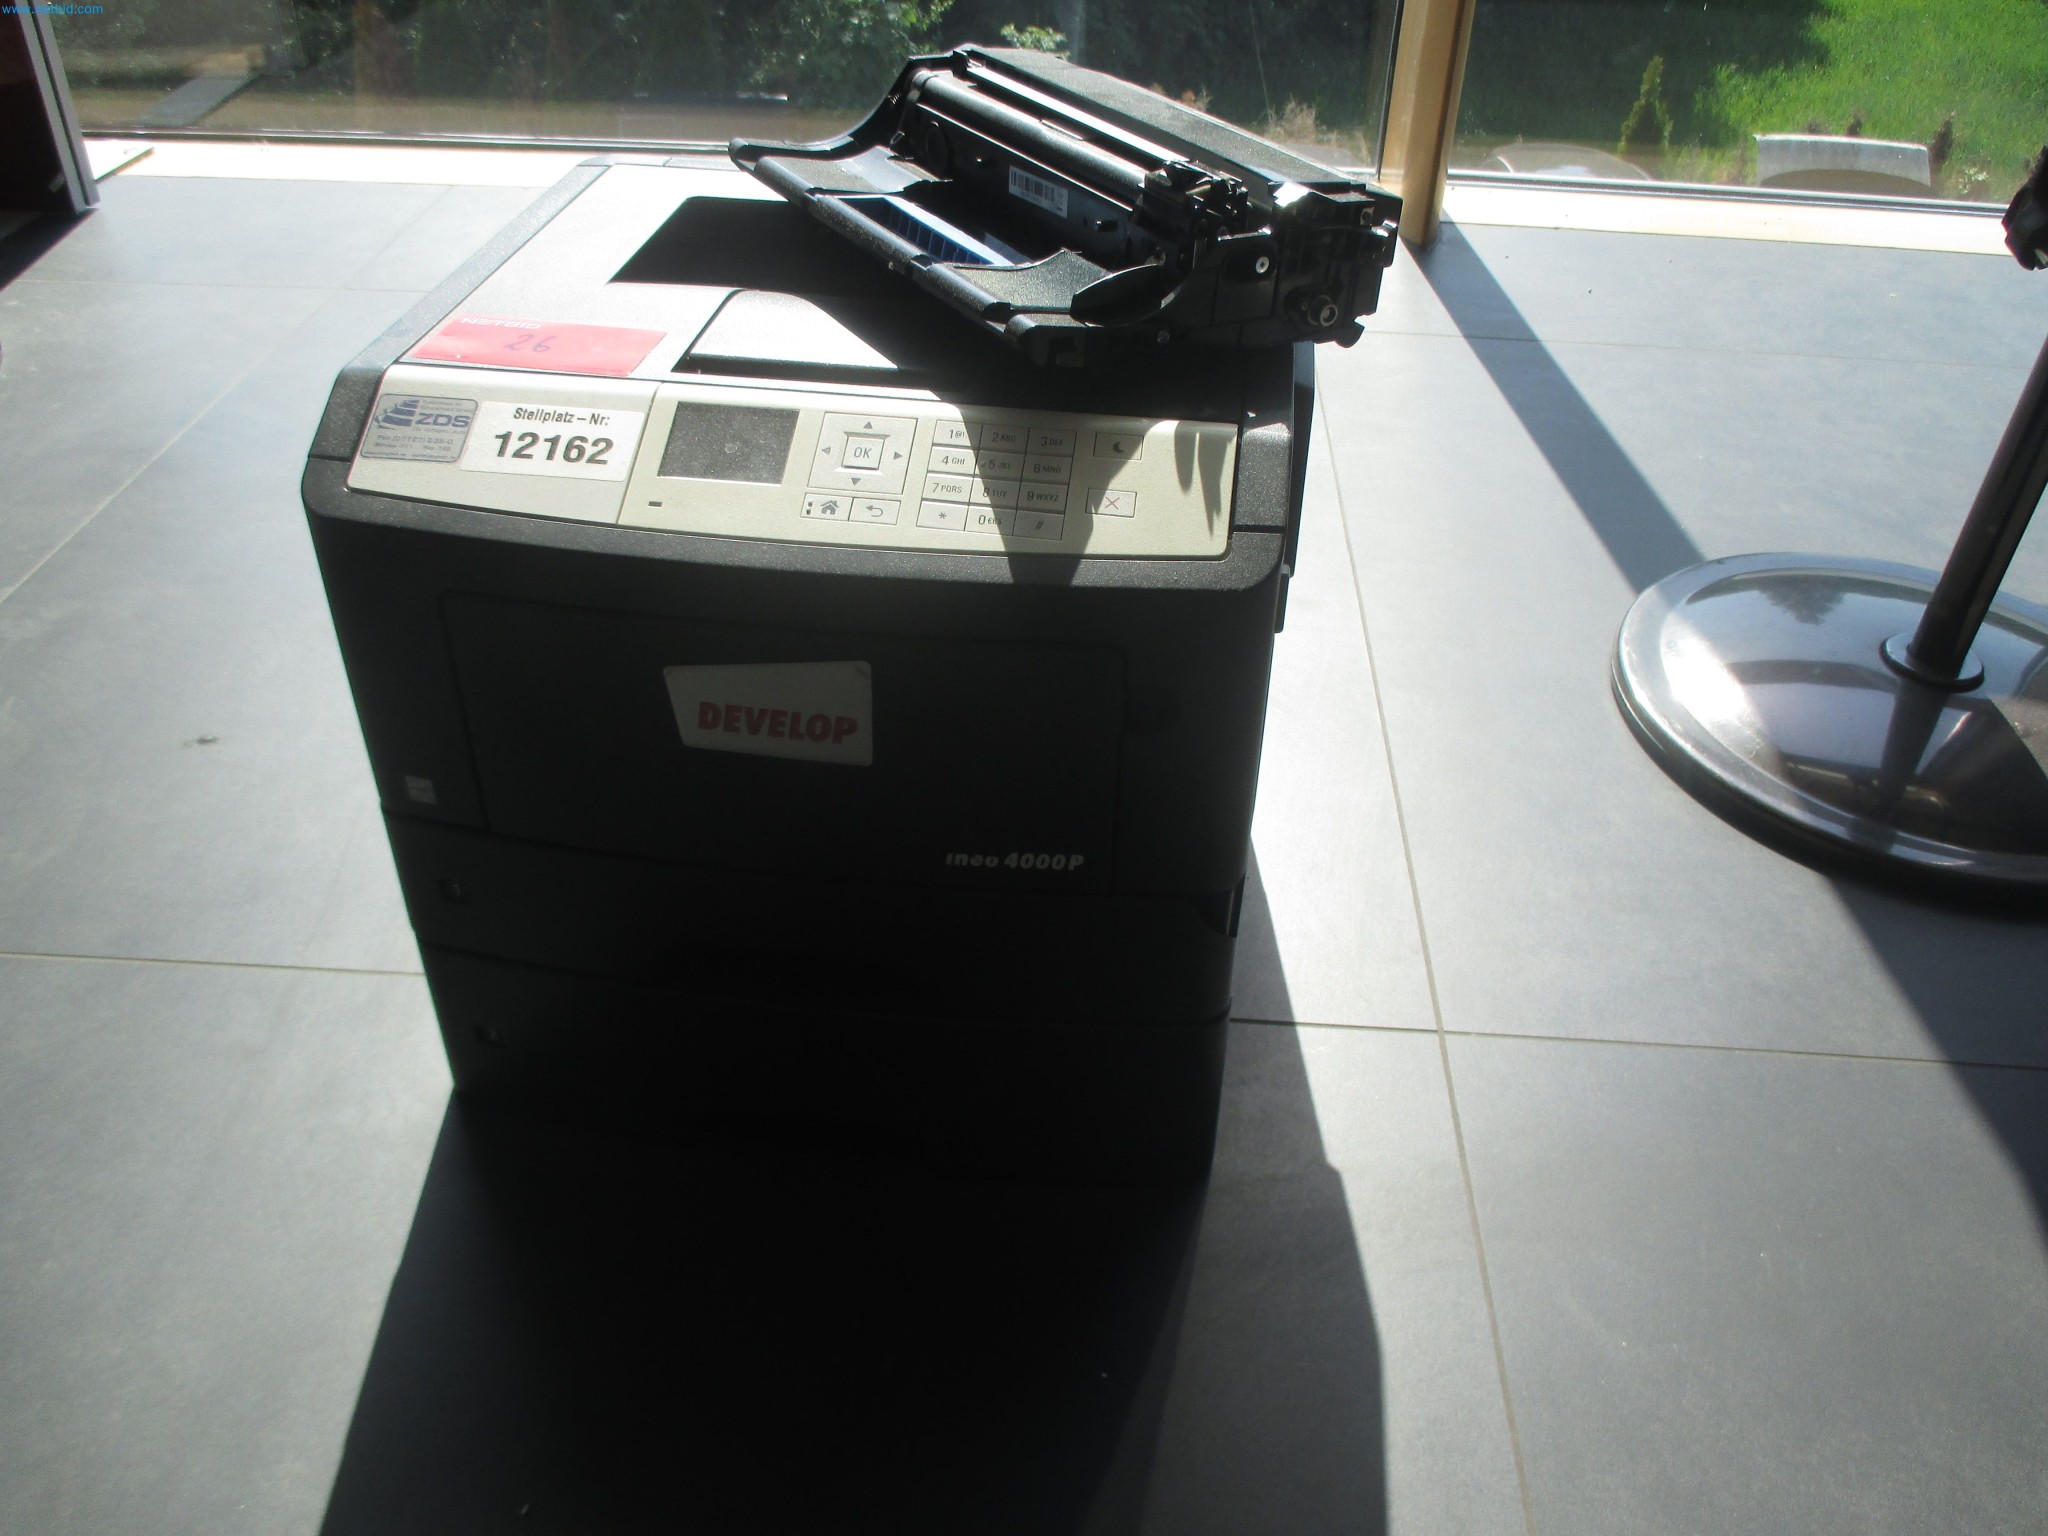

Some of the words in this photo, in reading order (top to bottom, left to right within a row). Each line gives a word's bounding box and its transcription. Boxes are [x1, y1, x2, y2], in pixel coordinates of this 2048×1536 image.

[460, 317, 541, 330] NETBID
[503, 333, 557, 353] 26
[415, 412, 471, 428] ZDS
[513, 407, 575, 424] Stellplatz
[991, 432, 999, 442] 2
[1040, 436, 1048, 447] 3
[494, 430, 614, 466] 12162
[853, 446, 871, 459] OK
[941, 455, 949, 466] 4
[951, 457, 966, 465] GHI
[988, 459, 996, 469] 5
[1033, 463, 1041, 474] 6
[1042, 465, 1062, 474] MNO
[932, 482, 940, 493] 7
[940, 484, 963, 494] PQRS
[982, 487, 990, 498] 8
[992, 489, 1008, 498] TUV
[1026, 490, 1035, 501] 9
[1036, 493, 1060, 502] WXYZ
[697, 700, 859, 745] DEVELOP
[1003, 852, 1085, 871] 4000P
